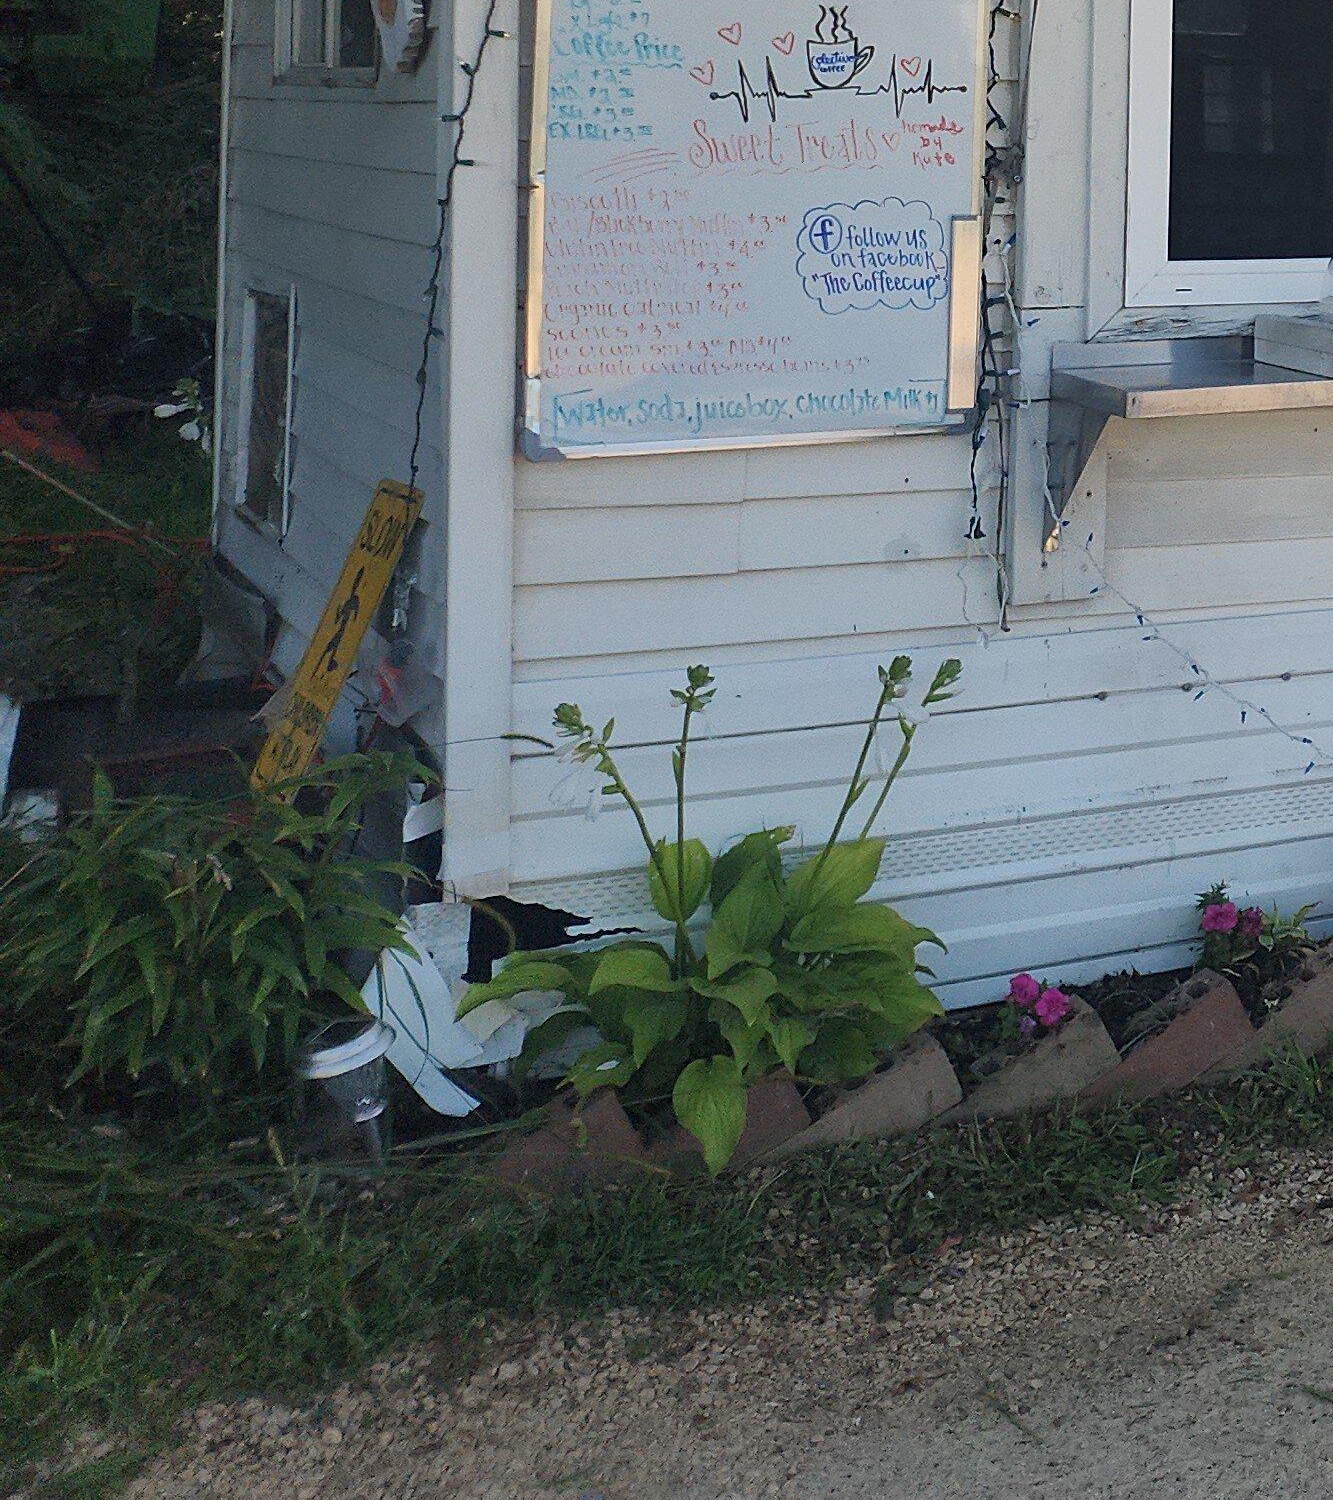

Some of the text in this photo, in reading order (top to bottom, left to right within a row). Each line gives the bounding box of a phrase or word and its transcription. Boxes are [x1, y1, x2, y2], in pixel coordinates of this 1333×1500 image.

[689, 118, 878, 170] Sweet Treats
[846, 224, 928, 249] follow us
[831, 249, 937, 272] on facebook
